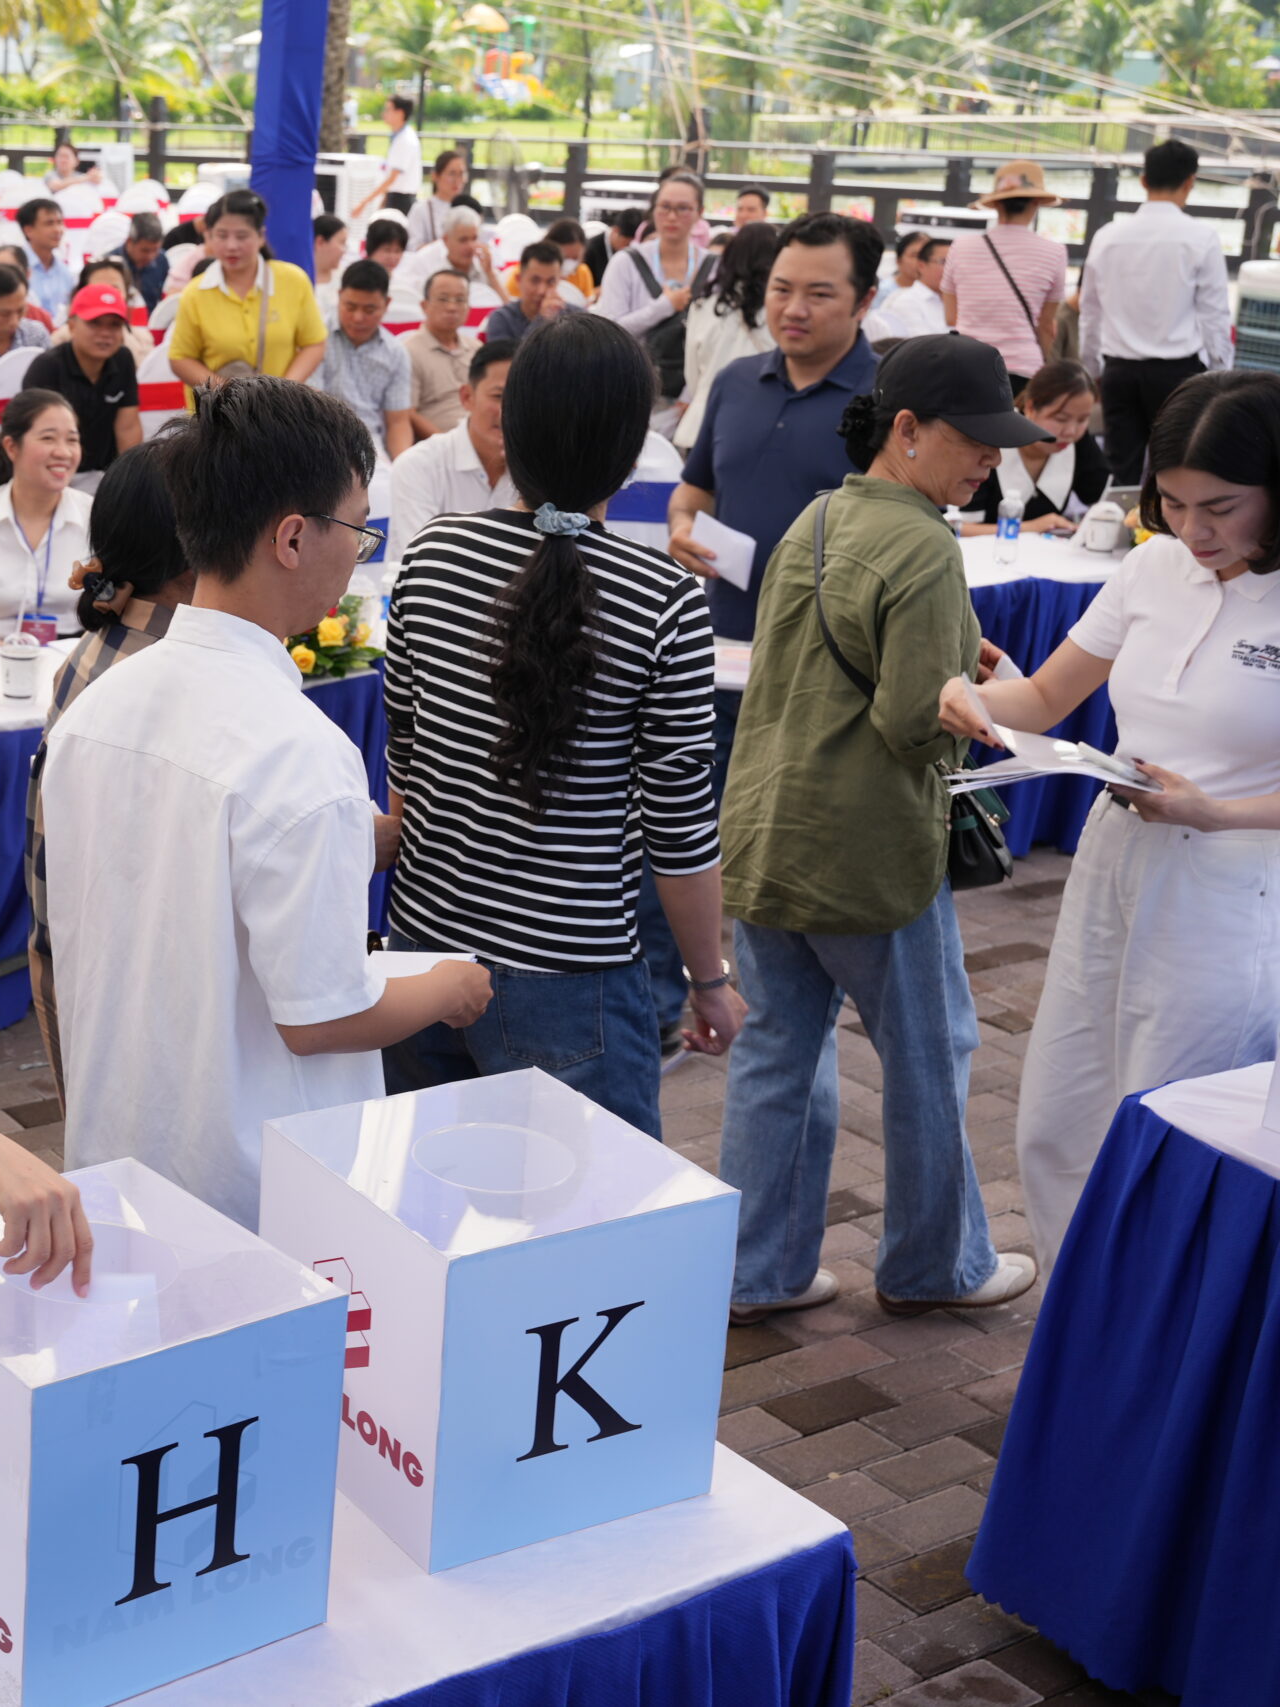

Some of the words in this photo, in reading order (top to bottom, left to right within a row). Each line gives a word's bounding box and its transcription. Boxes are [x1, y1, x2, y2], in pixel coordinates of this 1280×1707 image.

[341, 1392, 424, 1487] LONG
[516, 1300, 645, 1463] K
[115, 1416, 259, 1606] H
[51, 1591, 176, 1657] NAM
[191, 1535, 317, 1605] LONG
